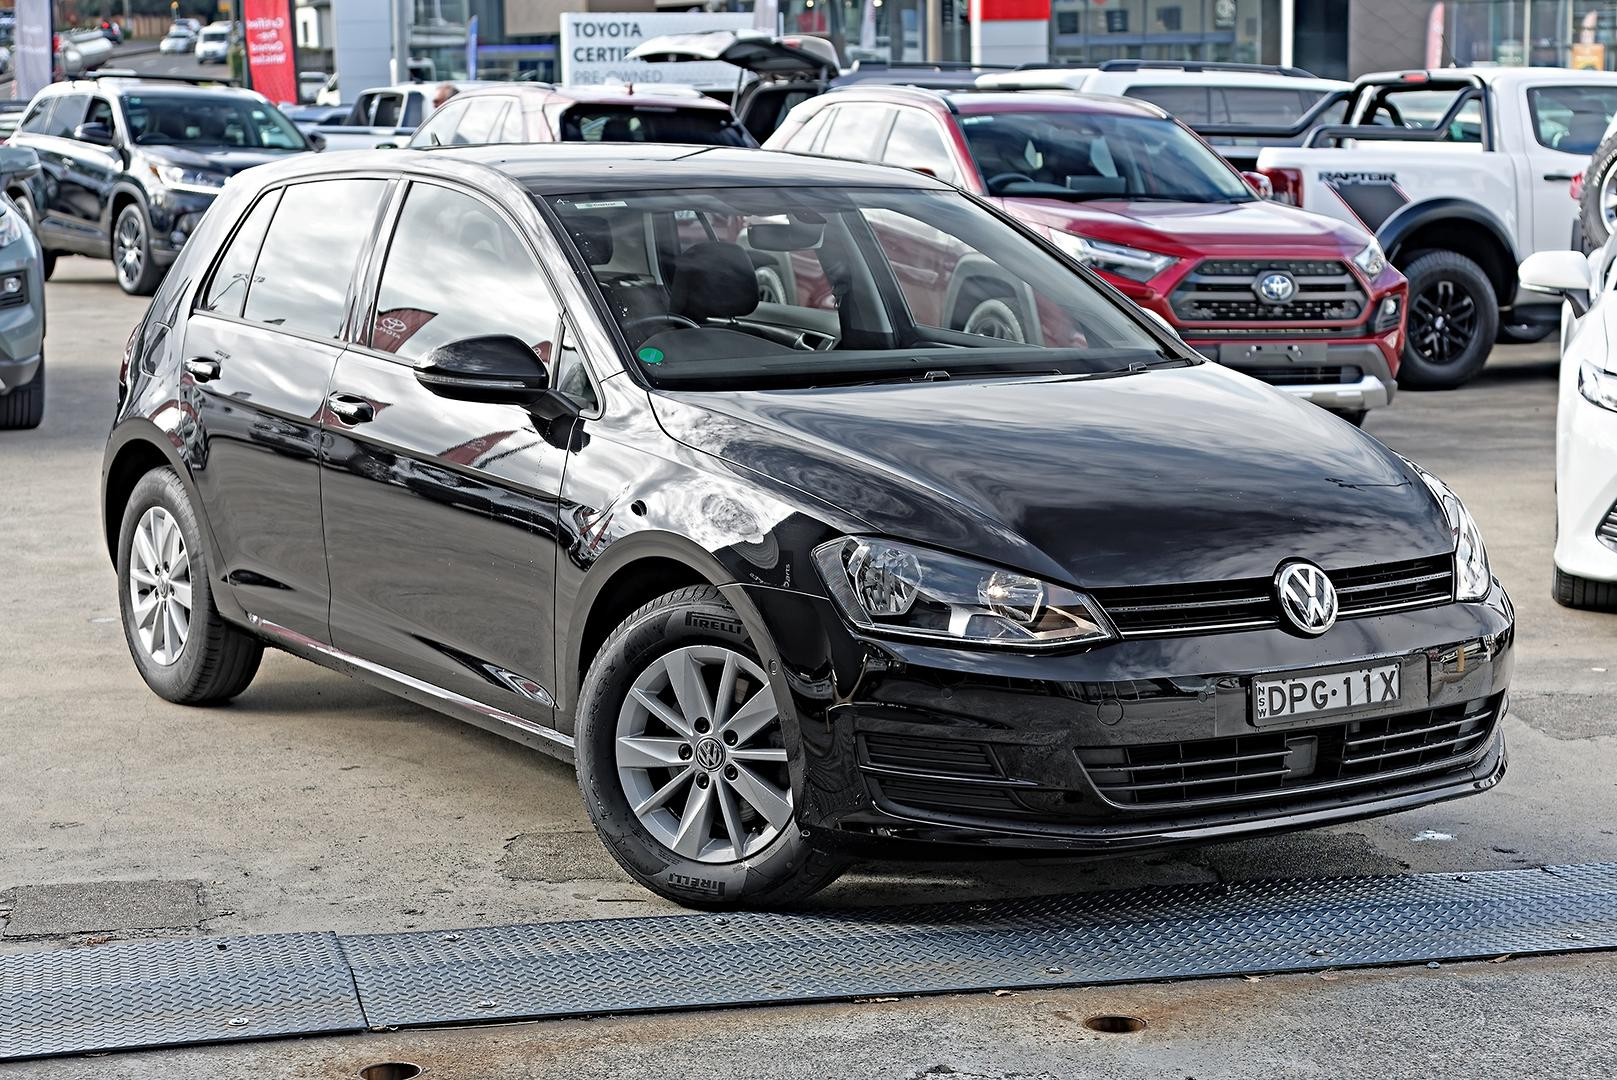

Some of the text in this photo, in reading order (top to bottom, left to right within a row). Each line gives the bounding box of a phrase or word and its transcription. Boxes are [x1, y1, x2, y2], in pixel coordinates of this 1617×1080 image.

[574, 22, 642, 38] TOYOTA
[1318, 171, 1397, 182] RAPTOR
[685, 611, 743, 635] PIRELLI
[668, 873, 726, 897] PIRELLI
